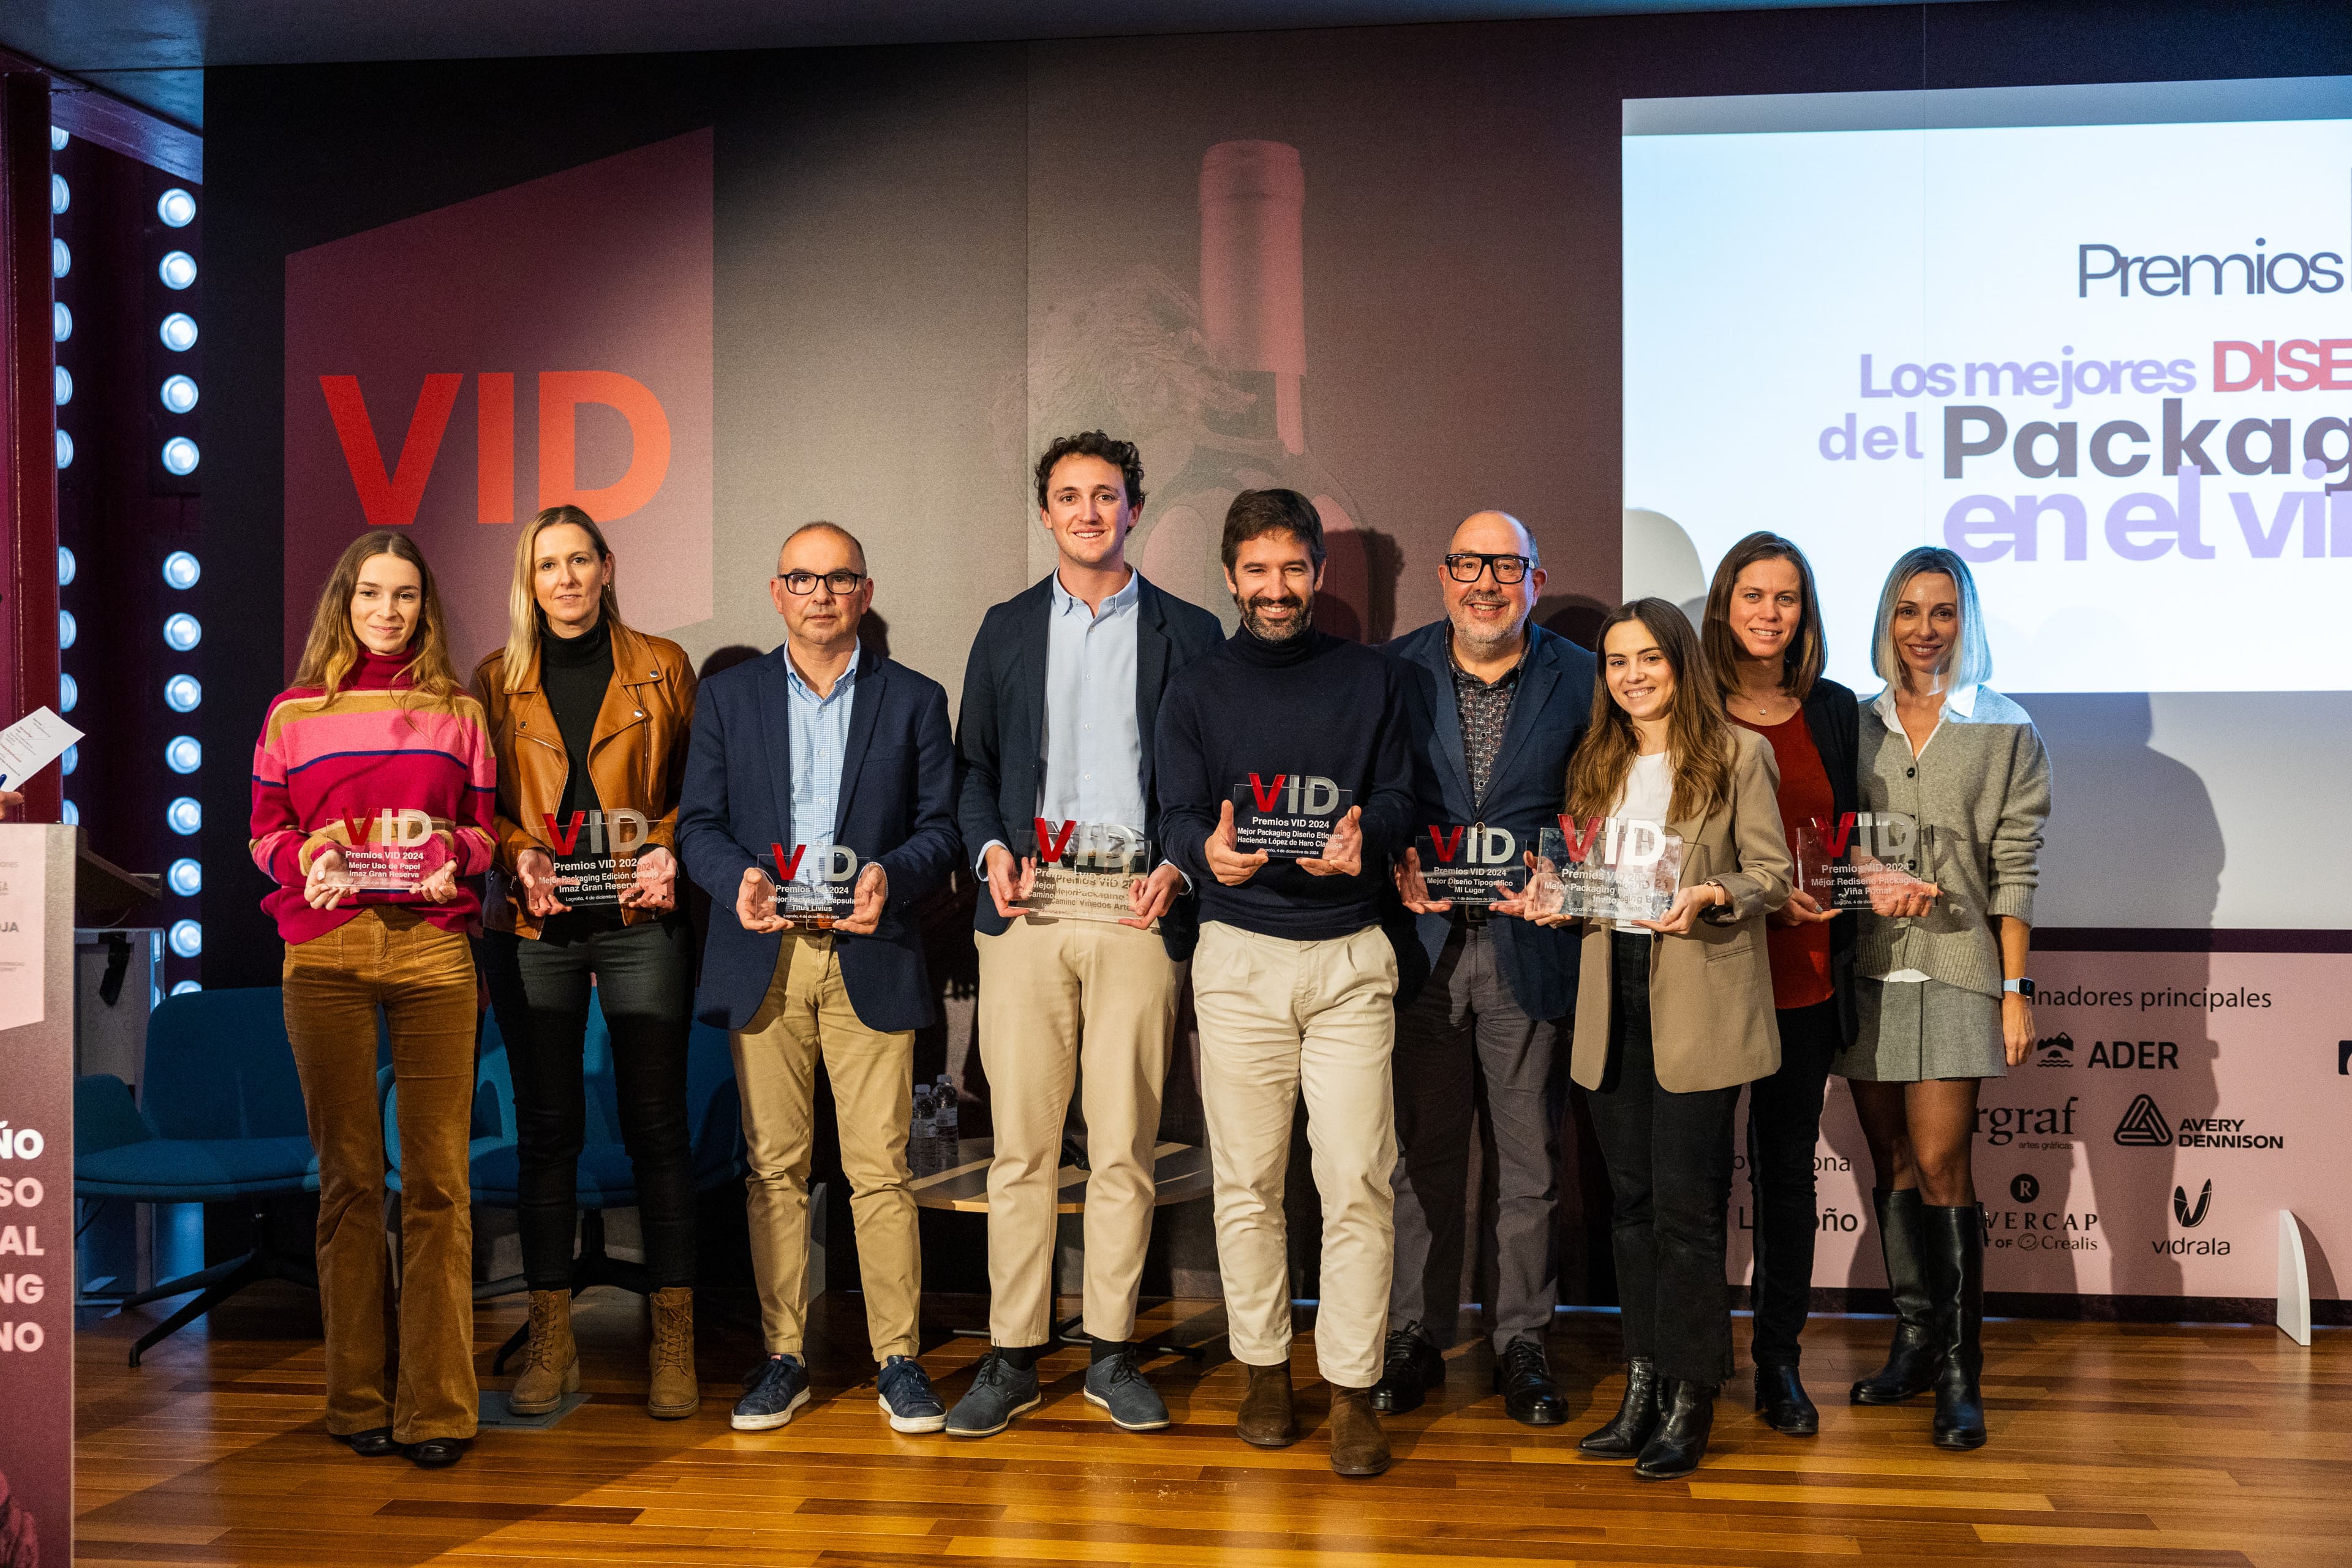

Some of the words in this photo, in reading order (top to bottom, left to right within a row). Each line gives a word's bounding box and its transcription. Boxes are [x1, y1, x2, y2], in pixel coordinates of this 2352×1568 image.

[2079, 238, 2344, 298] Premios
[1860, 353, 1956, 398] Los
[1964, 346, 2197, 409] mejores
[318, 370, 671, 525] VID
[1819, 412, 1923, 461] del
[1943, 491, 2087, 563] en
[2105, 466, 2215, 561] el
[1248, 773, 1339, 815] VID
[341, 808, 432, 847] VID
[541, 808, 649, 856] VID
[1252, 816, 1289, 826] Premios
[1308, 820, 1330, 829] 2024
[1034, 817, 1135, 868] VID
[1237, 827, 1256, 836] Mejor
[1257, 829, 1291, 839] Packaging
[1316, 832, 1343, 842] Etiqueta
[1268, 837, 1287, 846] López
[1428, 825, 1515, 864] VID
[1557, 813, 1666, 865] VID
[1811, 812, 1916, 857] VID
[553, 861, 597, 871] Premios
[597, 859, 616, 869] VID
[771, 843, 858, 881] VID
[1822, 864, 1862, 873] Premios
[1886, 863, 1910, 872] 2024
[539, 876, 559, 886] Mejor
[562, 874, 600, 883] Packaging
[601, 872, 630, 881] Edición
[1562, 869, 1605, 880] Premios
[1811, 878, 1834, 888] Mejor
[1879, 876, 1922, 885] Packaging
[775, 885, 810, 894] Premios
[1544, 881, 1569, 892] Mejor
[1570, 883, 1615, 895] Packaging
[2141, 987, 2272, 1012] principales
[2087, 1041, 2179, 1069] ADER
[2179, 1118, 2245, 1132] AVERY
[2041, 1141, 2074, 1151] gráficas
[2179, 1134, 2283, 1149] DENNISON
[2041, 1235, 2098, 1250] Crealis
[2151, 1237, 2231, 1256] vidrala
